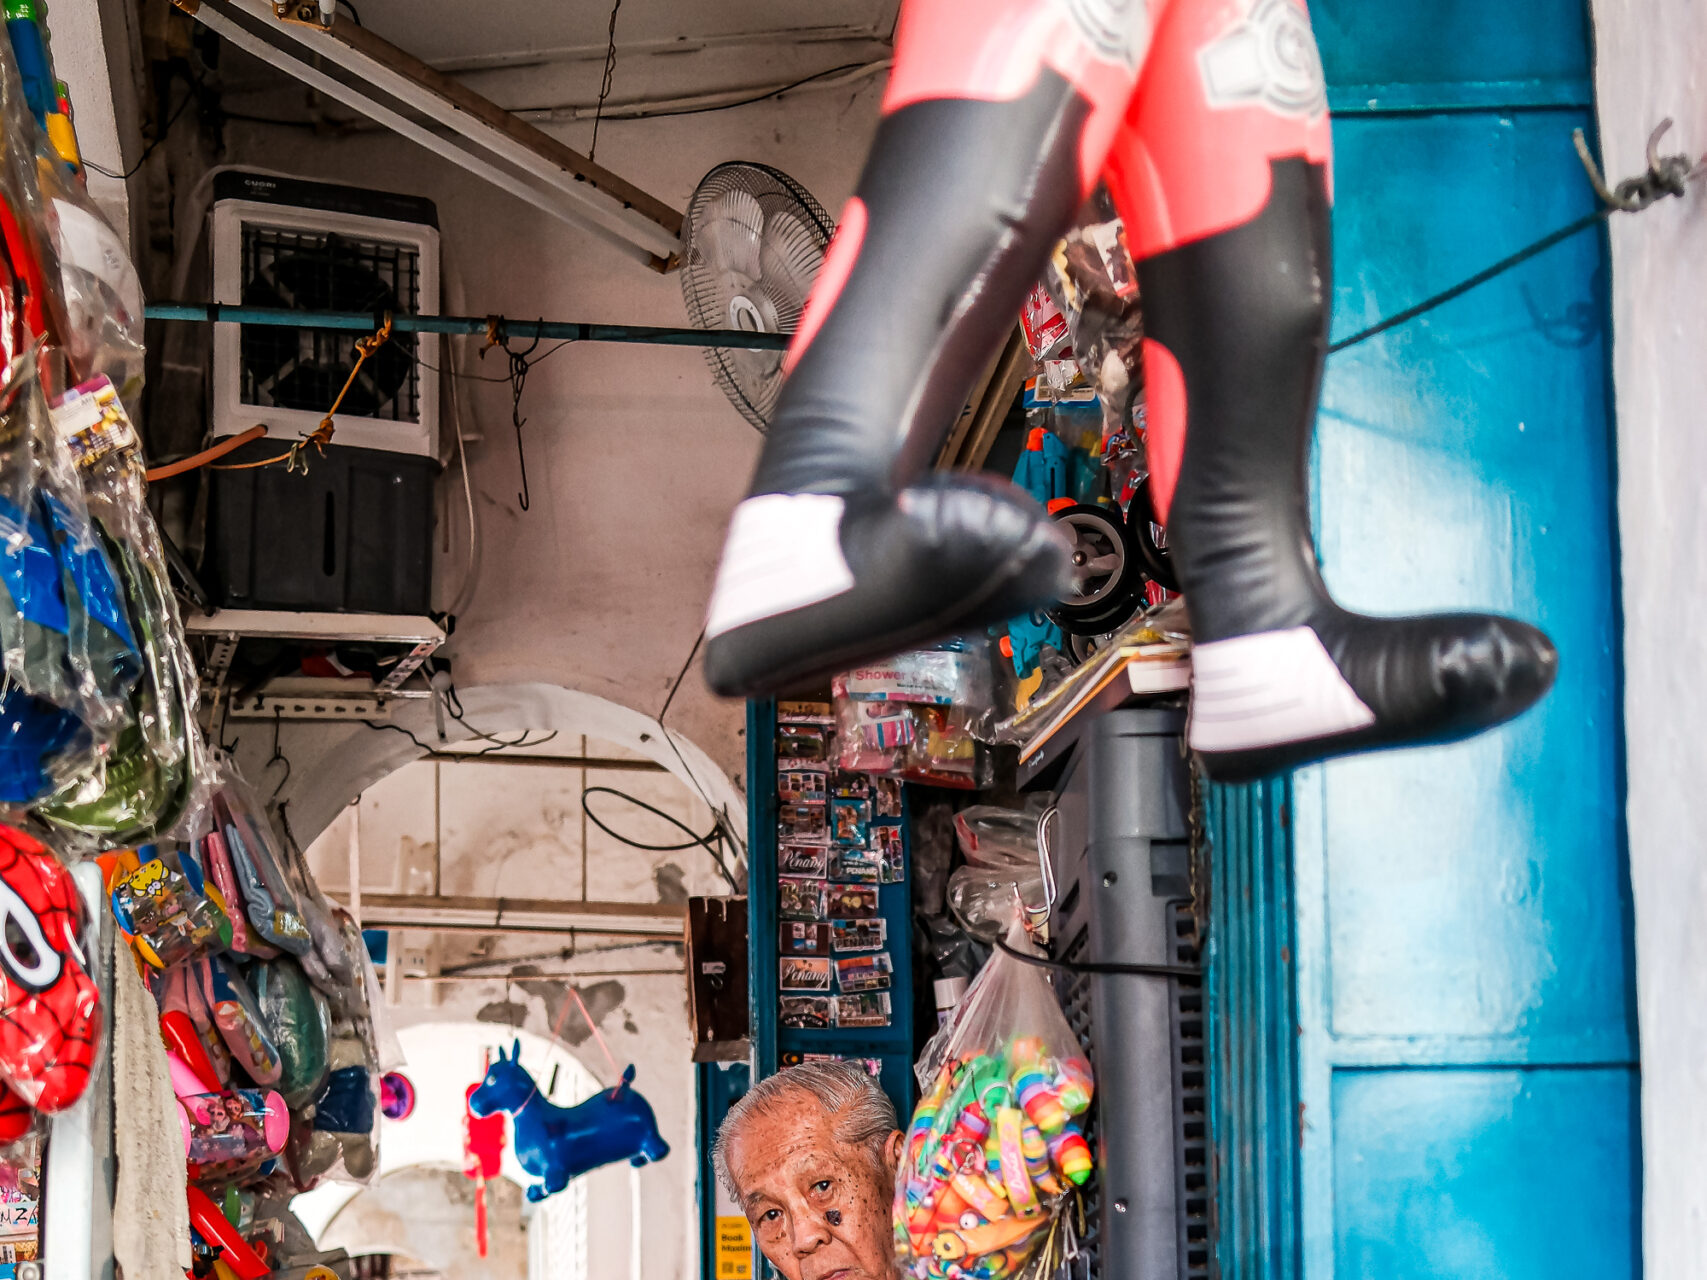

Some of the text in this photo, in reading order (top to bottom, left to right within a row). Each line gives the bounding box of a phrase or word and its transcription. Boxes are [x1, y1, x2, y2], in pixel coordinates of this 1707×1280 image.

[856, 669, 906, 681] Shower
[783, 851, 826, 877] Penang
[785, 964, 829, 989] Penang
